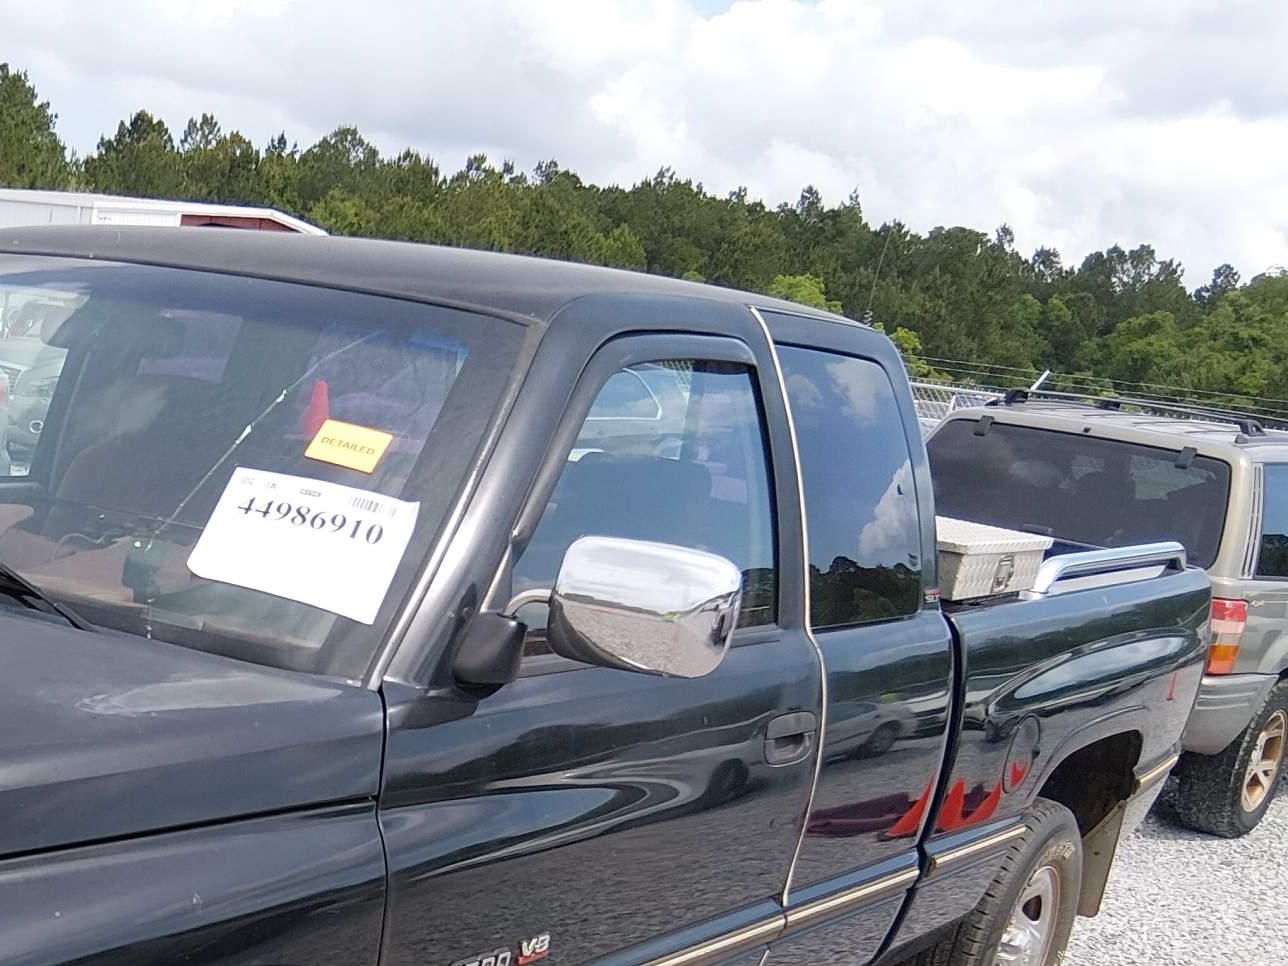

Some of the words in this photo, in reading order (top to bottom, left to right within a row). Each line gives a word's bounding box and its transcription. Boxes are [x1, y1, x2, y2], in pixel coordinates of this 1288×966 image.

[321, 436, 375, 455] DETAILED
[237, 496, 384, 545] 44986910
[521, 933, 550, 957] V8
